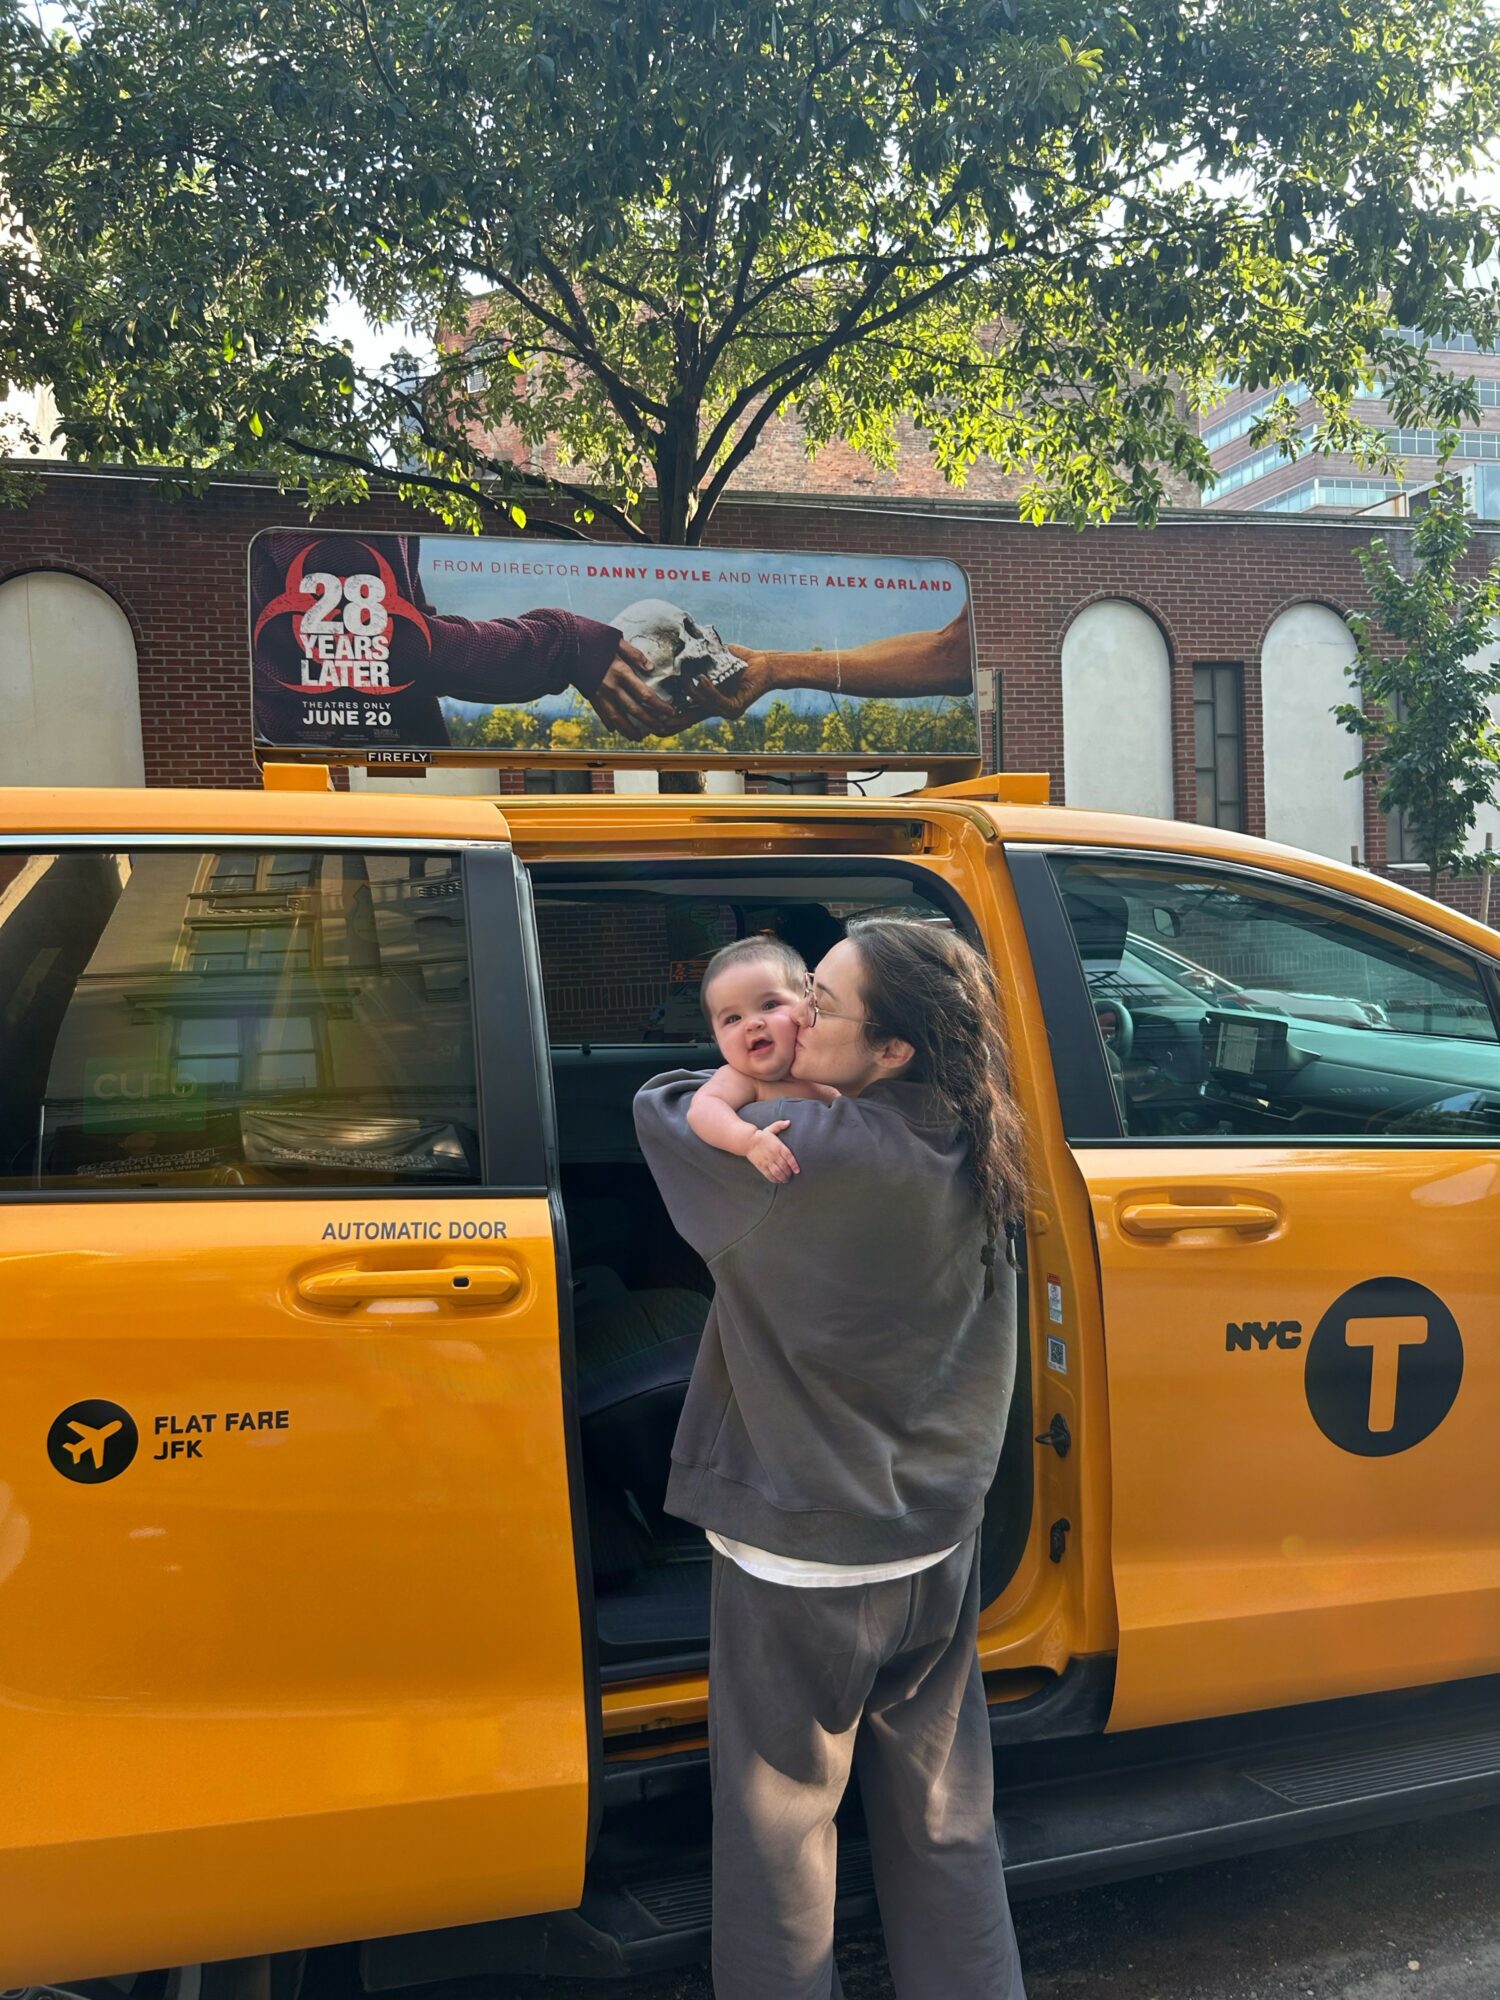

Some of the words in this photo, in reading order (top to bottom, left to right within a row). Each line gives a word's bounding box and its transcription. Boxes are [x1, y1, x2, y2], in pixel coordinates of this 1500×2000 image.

[433, 559, 483, 574] FROM
[490, 561, 580, 577] DIRECTOR
[586, 565, 648, 579] DANNY
[655, 568, 712, 582] BOYLE
[718, 571, 752, 584] AND
[758, 572, 820, 587] WRITER
[826, 575, 869, 589] ALEX
[874, 577, 953, 592] GARLAND
[299, 572, 389, 637] 28
[299, 634, 390, 661] YEARS
[300, 659, 390, 688] LATER
[302, 701, 359, 710] THEATRES
[363, 702, 392, 711] ONLY
[302, 710, 359, 726] JUNE
[365, 710, 392, 726] 20
[368, 752, 429, 763] FIREFLY
[322, 1222, 442, 1240] AUTOMATIC
[449, 1221, 507, 1240] DOOR
[1226, 1321, 1302, 1352] NYC
[1345, 1315, 1429, 1433] T
[155, 1413, 217, 1435] FLAT
[225, 1410, 290, 1432] FARE
[153, 1439, 204, 1461] JFK
